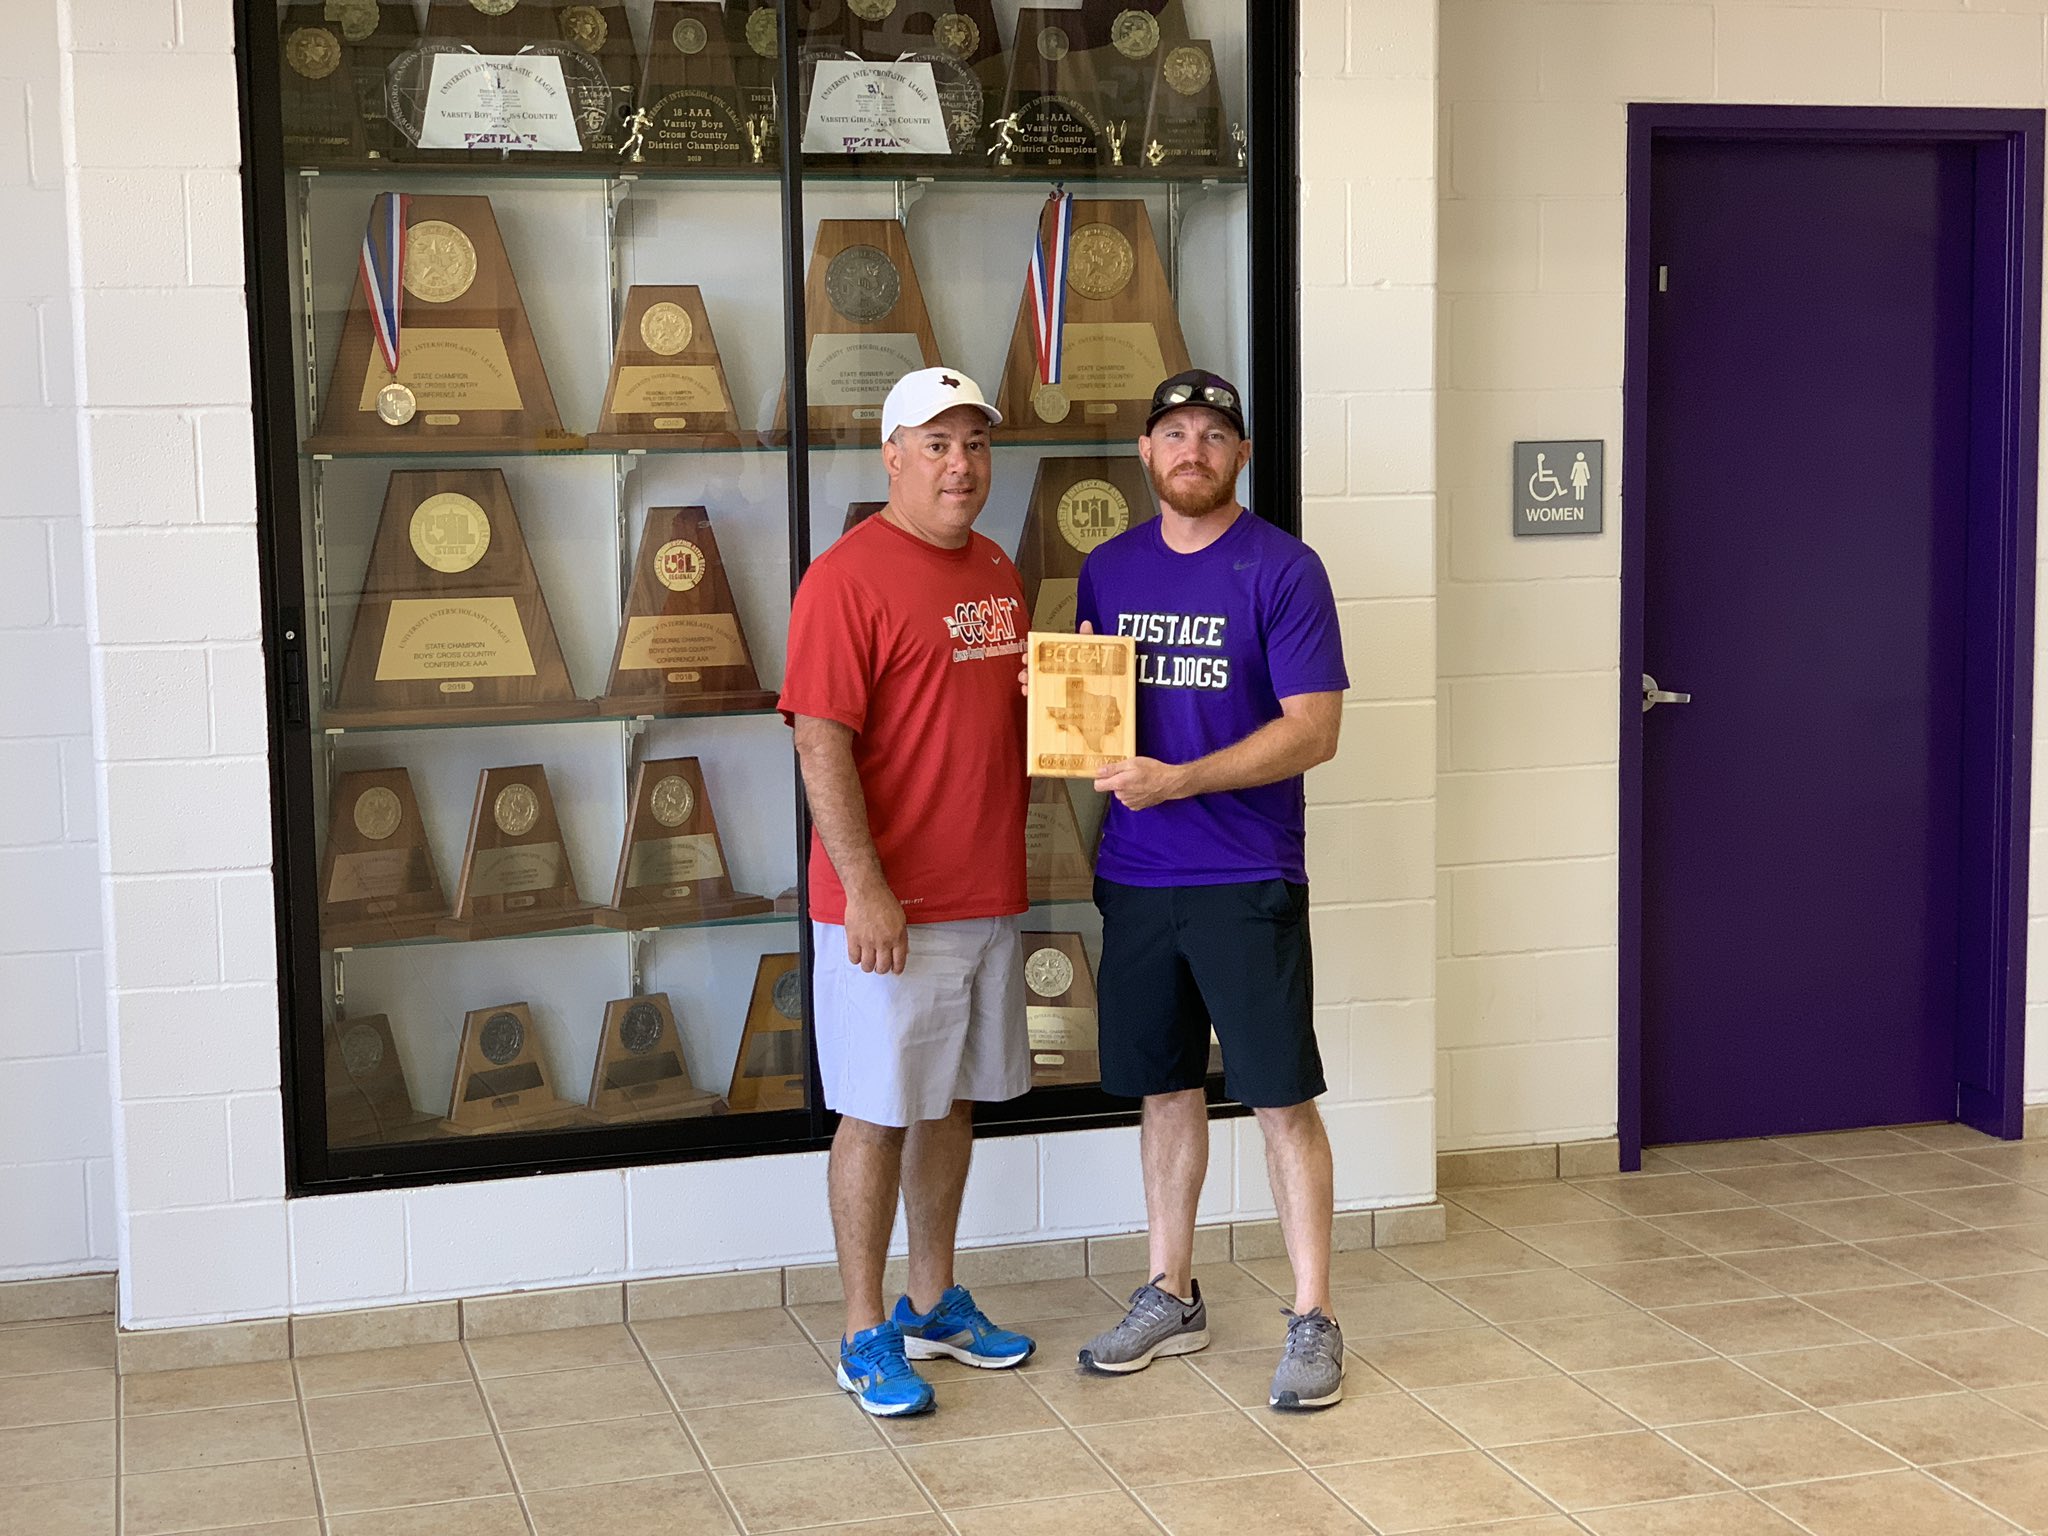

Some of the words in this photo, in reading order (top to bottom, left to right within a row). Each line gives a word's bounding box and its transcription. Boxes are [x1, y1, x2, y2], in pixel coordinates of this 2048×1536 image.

[522, 111, 558, 120] COUNTRY
[898, 116, 931, 125] COUNTRY
[663, 119, 697, 129] Varsity
[701, 119, 724, 130] Boys
[1026, 123, 1058, 134] Varsity
[1061, 124, 1083, 133] Girls
[659, 130, 686, 139] Cross
[690, 130, 728, 141] Country
[1022, 134, 1048, 143] Cross
[1051, 134, 1087, 145] Country
[648, 140, 683, 149] District
[687, 141, 740, 152] Champions
[1012, 144, 1044, 153] District
[1047, 145, 1098, 155] Champions
[413, 372, 432, 380] STATE
[435, 372, 469, 380] CHAMPION
[1525, 506, 1585, 522] WOMEN
[1079, 527, 1108, 538] STATE
[434, 545, 467, 555] STATE
[668, 573, 693, 581] REGIONAL
[399, 616, 430, 649] UNIVERSITY
[429, 608, 490, 624] INTERSCHOLASTIC
[1117, 613, 1226, 647] EUSTACE
[425, 642, 446, 650] STATE
[447, 641, 486, 650] CHAMPION
[436, 651, 462, 659] CROSS
[462, 650, 497, 658] COUNTRY
[423, 660, 472, 669] CONFERENCE
[472, 659, 489, 668] AAA
[656, 656, 696, 665] CONFERENCE
[1135, 654, 1229, 689] LLDOGS
